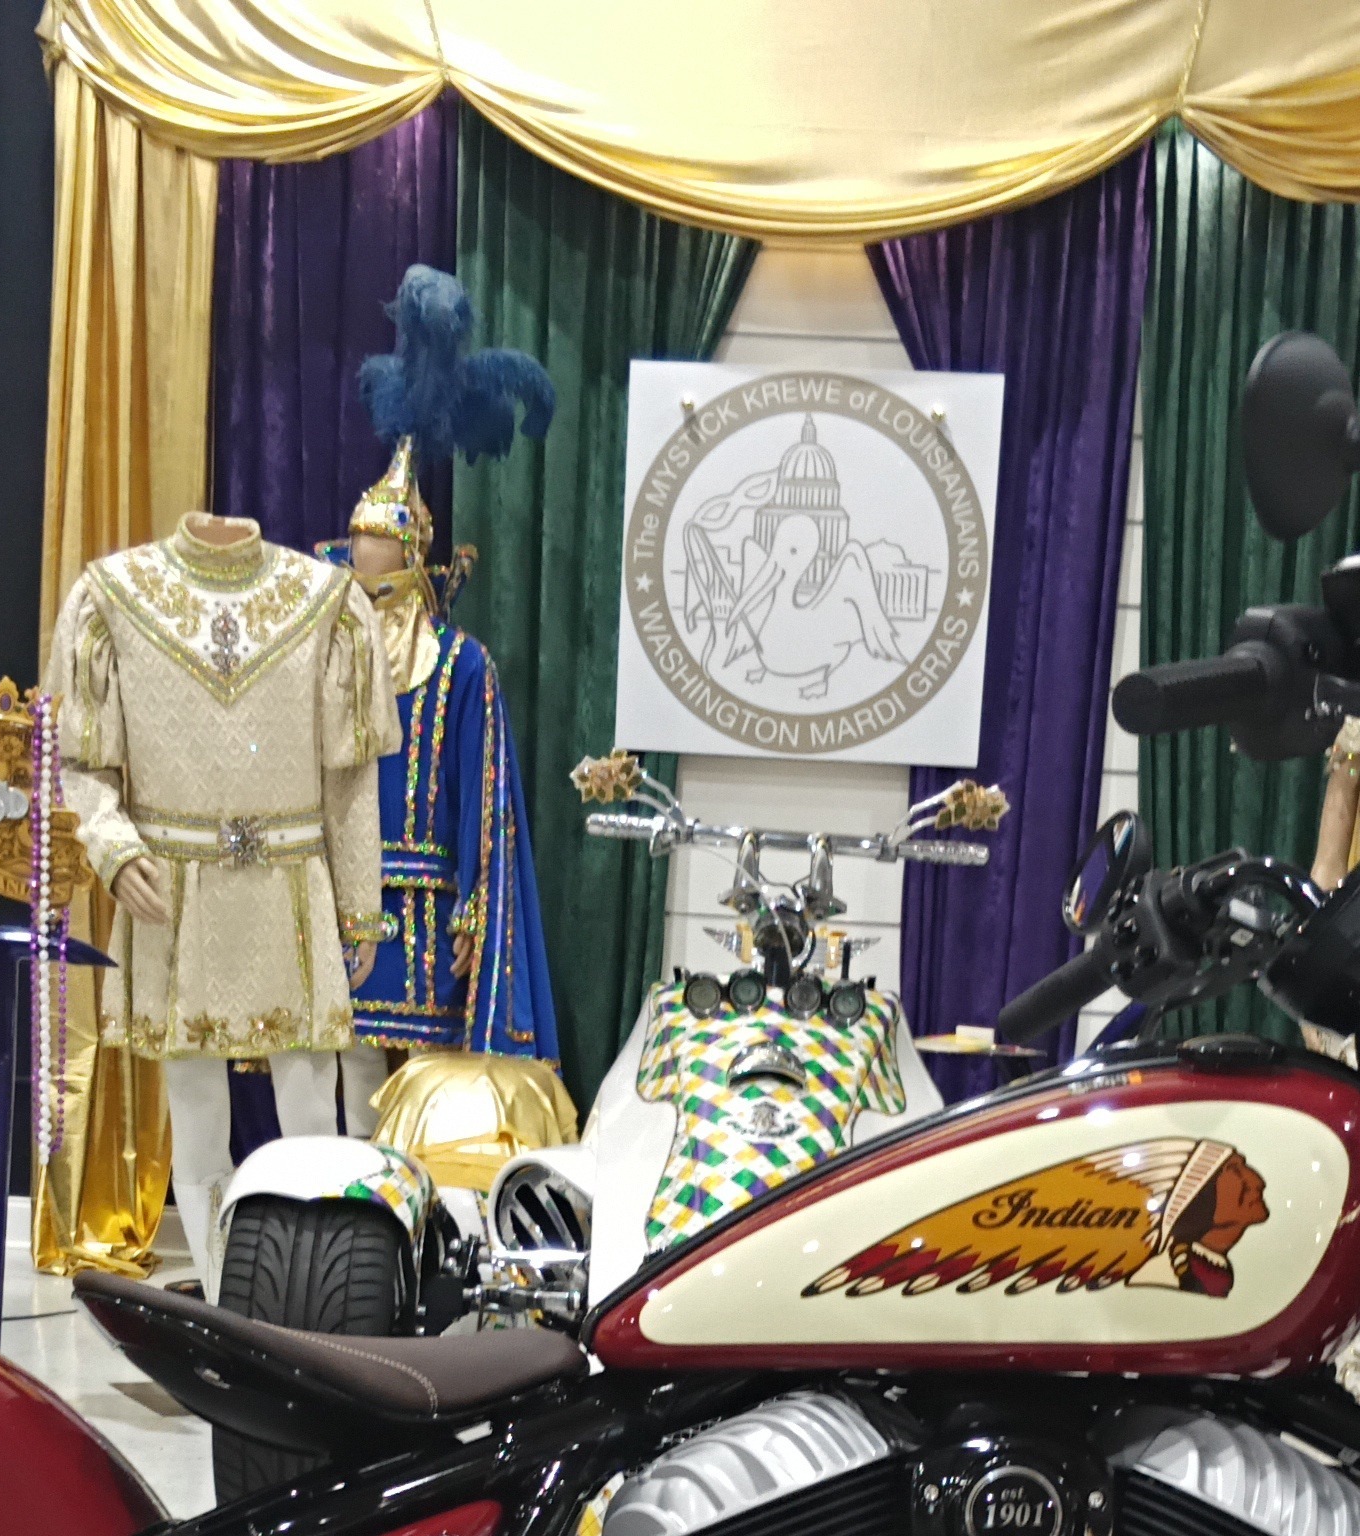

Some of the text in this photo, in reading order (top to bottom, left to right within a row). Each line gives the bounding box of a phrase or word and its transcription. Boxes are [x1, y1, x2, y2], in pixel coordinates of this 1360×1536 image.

[633, 378, 980, 580] The MYSTICK KREWE of LOUISIANIANS
[639, 601, 969, 748] WASHINGTON MARDI GRAS
[972, 1187, 1141, 1230] Indian
[984, 1502, 1044, 1528] 1901
